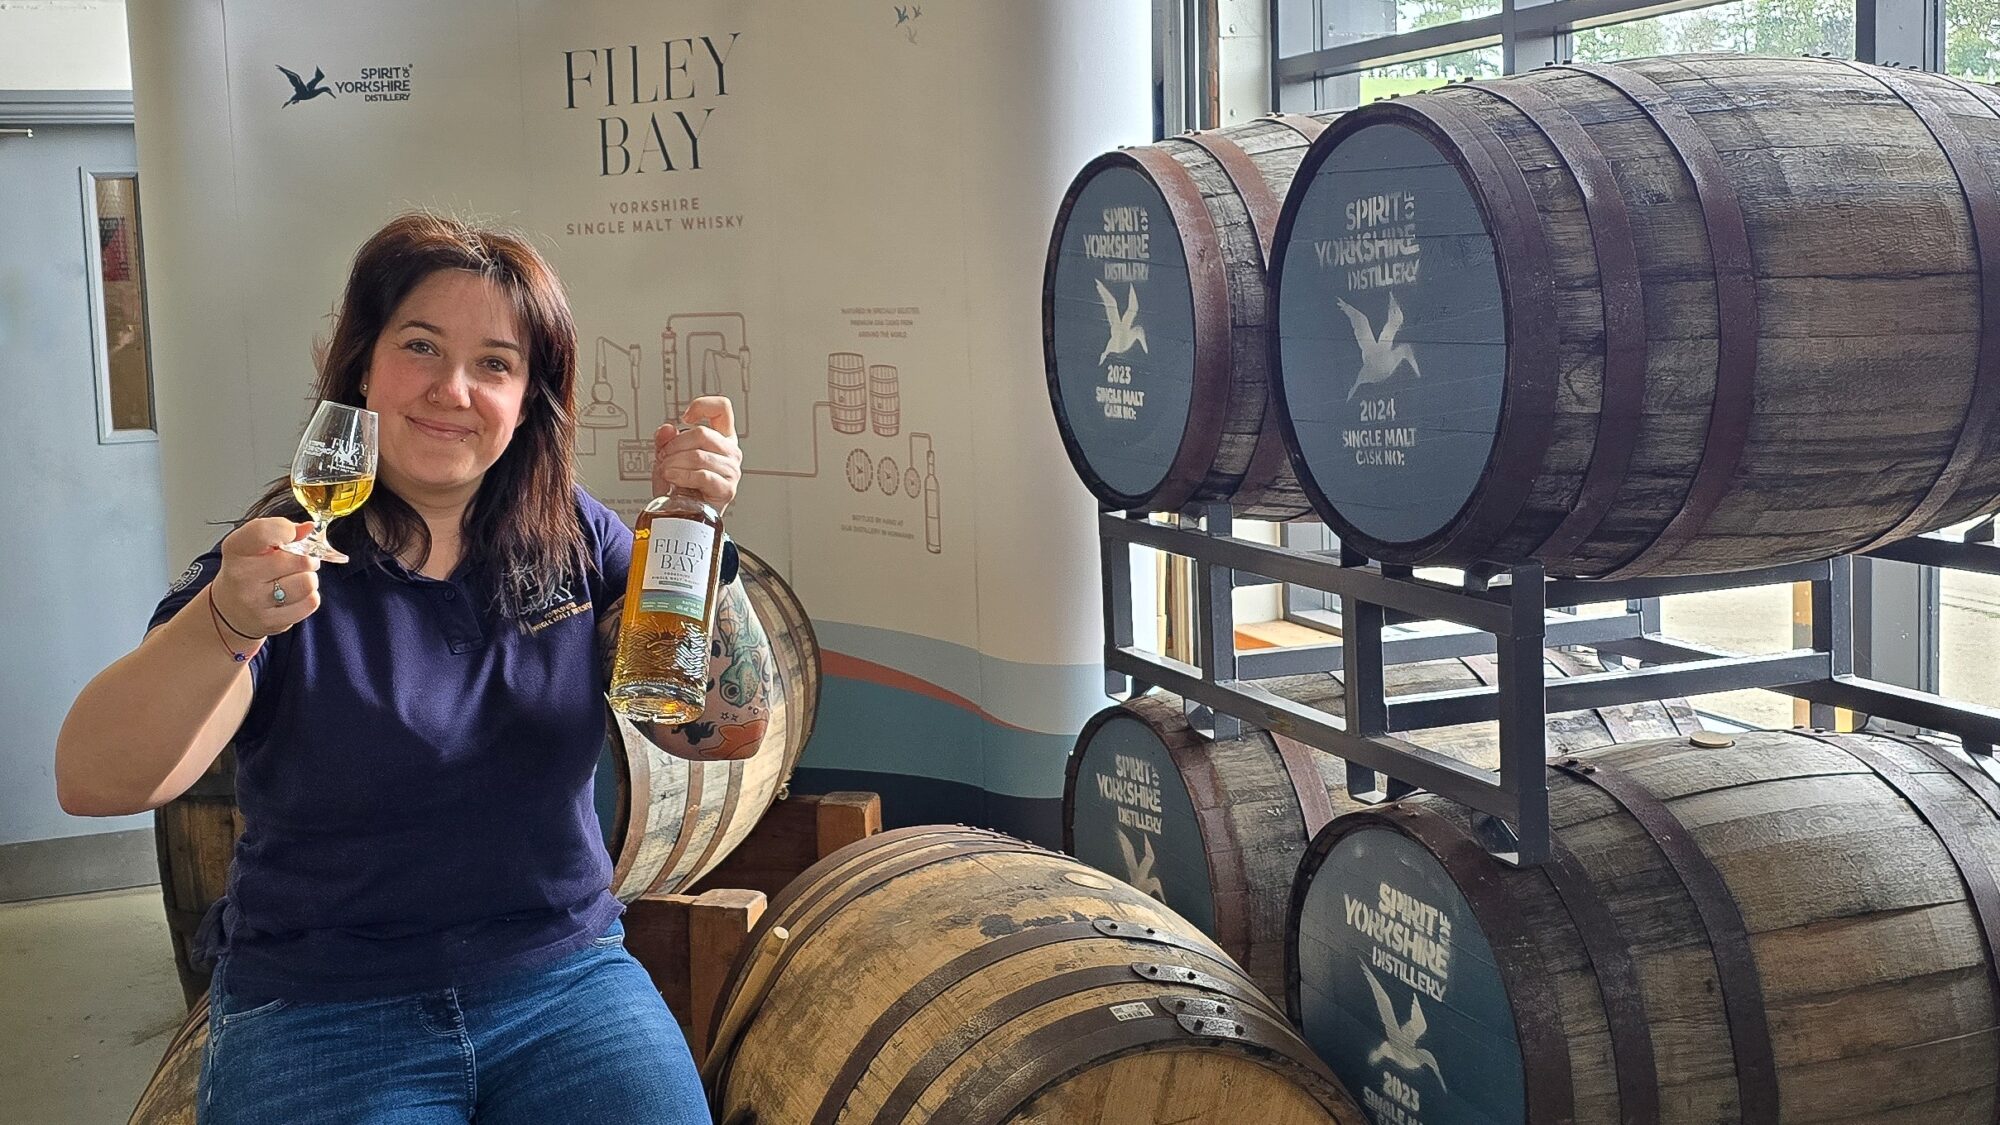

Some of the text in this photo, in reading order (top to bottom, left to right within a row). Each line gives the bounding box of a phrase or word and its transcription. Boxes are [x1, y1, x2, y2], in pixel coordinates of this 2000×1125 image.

[361, 66, 410, 80] SPIRIT OF
[562, 32, 741, 109] FILEY
[335, 80, 411, 94] YORKSHIRE
[365, 93, 411, 102] DISTILLERY
[597, 107, 716, 177] BAY
[610, 198, 700, 214] YORKSHIRE
[1345, 190, 1402, 231] SPIRIT
[566, 215, 744, 235] SINGLE MALT WHISKY
[1103, 206, 1139, 232] SPIRIT
[1083, 233, 1149, 259] YORKSHIRE
[1314, 224, 1420, 271] YORKSHIRE
[1104, 262, 1149, 281] DISTILLERY
[1347, 259, 1420, 291] DISTILLERY
[1107, 364, 1131, 384] 2023
[1096, 386, 1145, 407] SINGLE MALT
[1104, 404, 1122, 418] CASK
[1360, 398, 1397, 421] 2024
[1343, 427, 1416, 448] SINGLE MALT
[1356, 449, 1383, 465] CASK
[654, 538, 708, 560] FILEY
[660, 554, 699, 573] BAY
[1115, 754, 1151, 785] SPIRIT
[1096, 772, 1161, 813] YORKSHIRE
[1118, 806, 1162, 835] DISTILLERY
[1378, 882, 1438, 937] SPIRIT
[1344, 893, 1450, 980] YORKSHIRE
[1372, 946, 1447, 1002] DISTILLERY
[1383, 1071, 1419, 1111] 2023
